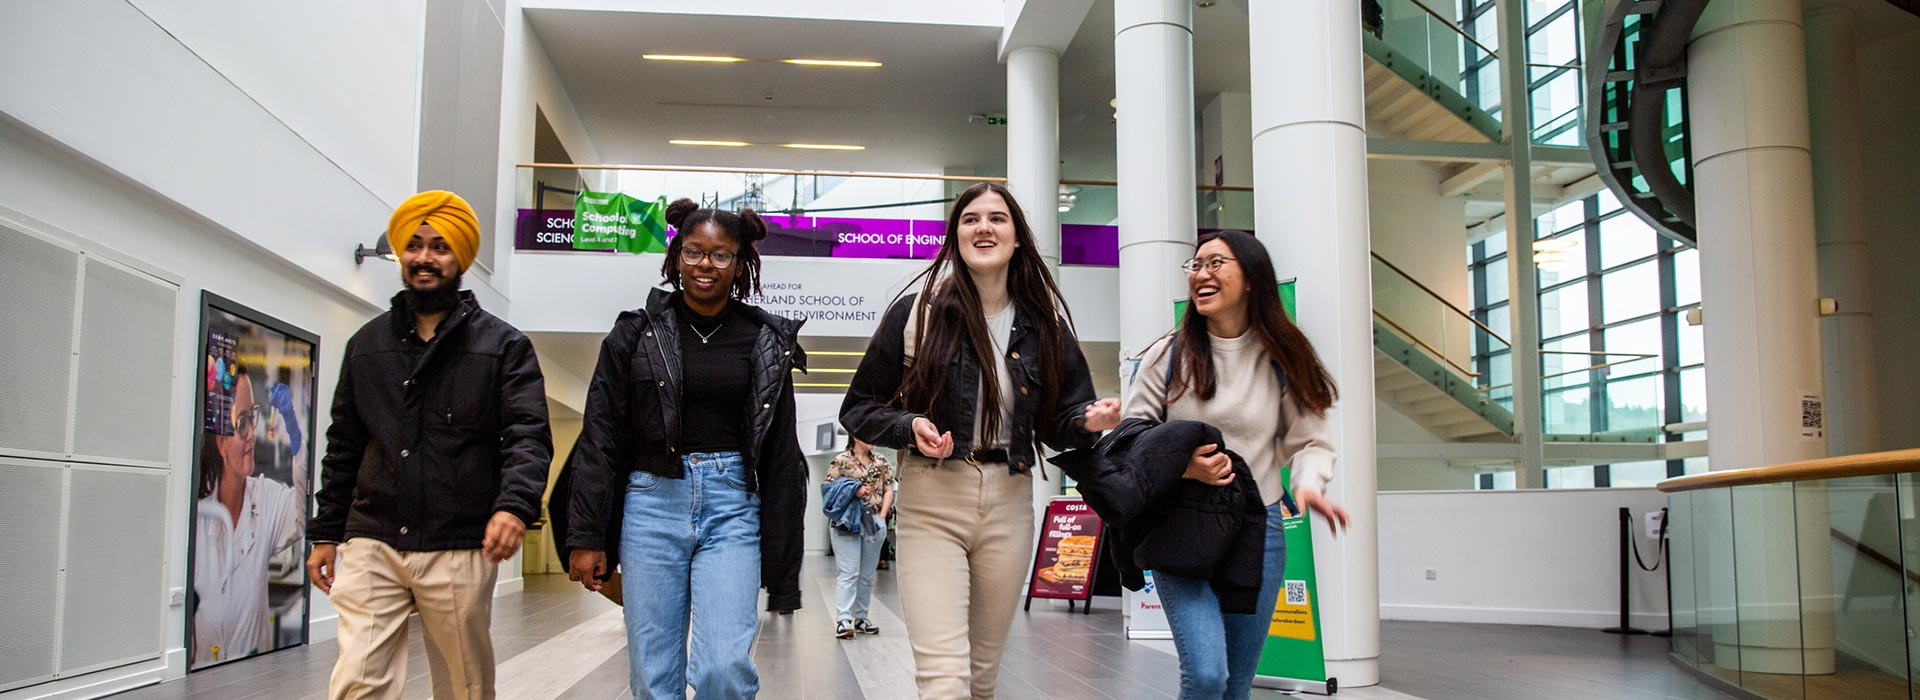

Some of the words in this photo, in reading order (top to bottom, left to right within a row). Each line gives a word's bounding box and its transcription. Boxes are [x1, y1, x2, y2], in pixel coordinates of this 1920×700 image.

[582, 211, 619, 222] School
[838, 232, 885, 244] SCHOOL
[887, 233, 903, 244] OF
[799, 295, 846, 306] SCHOOL
[848, 296, 864, 306] OF
[793, 311, 876, 321] ENVIRONMENT
[1065, 504, 1087, 512] COSTA
[1053, 515, 1067, 523] Full
[1067, 515, 1077, 523] of
[1058, 523, 1082, 531] full-on
